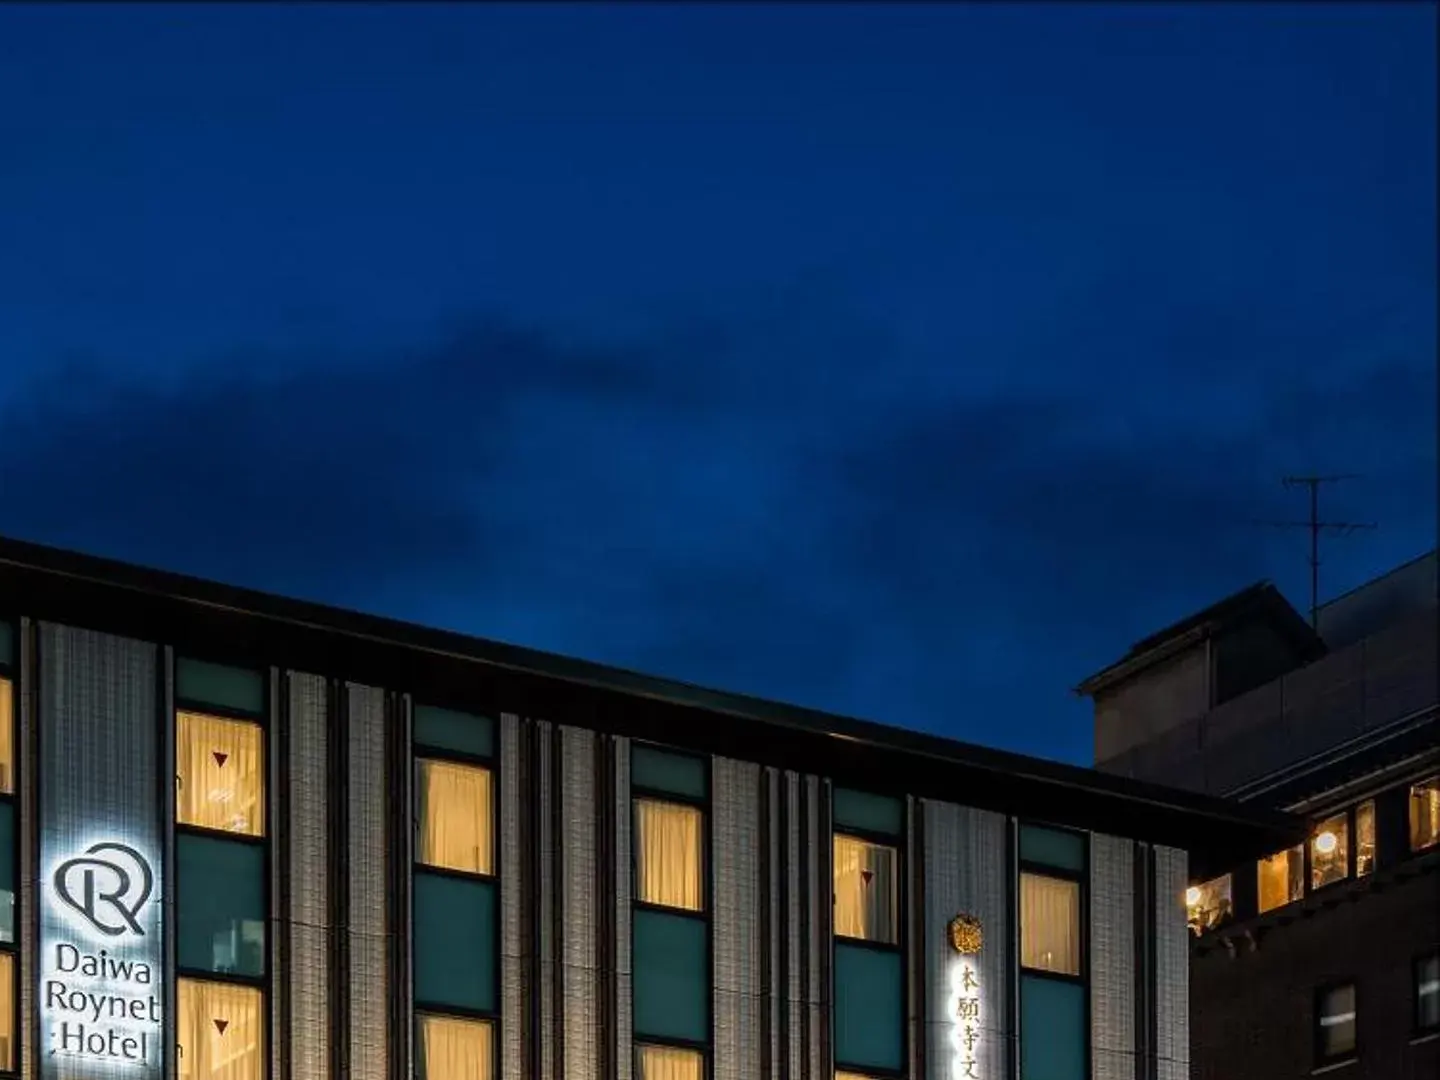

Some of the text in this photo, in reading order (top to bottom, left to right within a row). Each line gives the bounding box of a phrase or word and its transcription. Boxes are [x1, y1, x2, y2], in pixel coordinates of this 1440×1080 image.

[55, 943, 151, 984] Daiwa
[46, 980, 160, 1023] Roynet
[61, 1021, 148, 1060] Hotel
